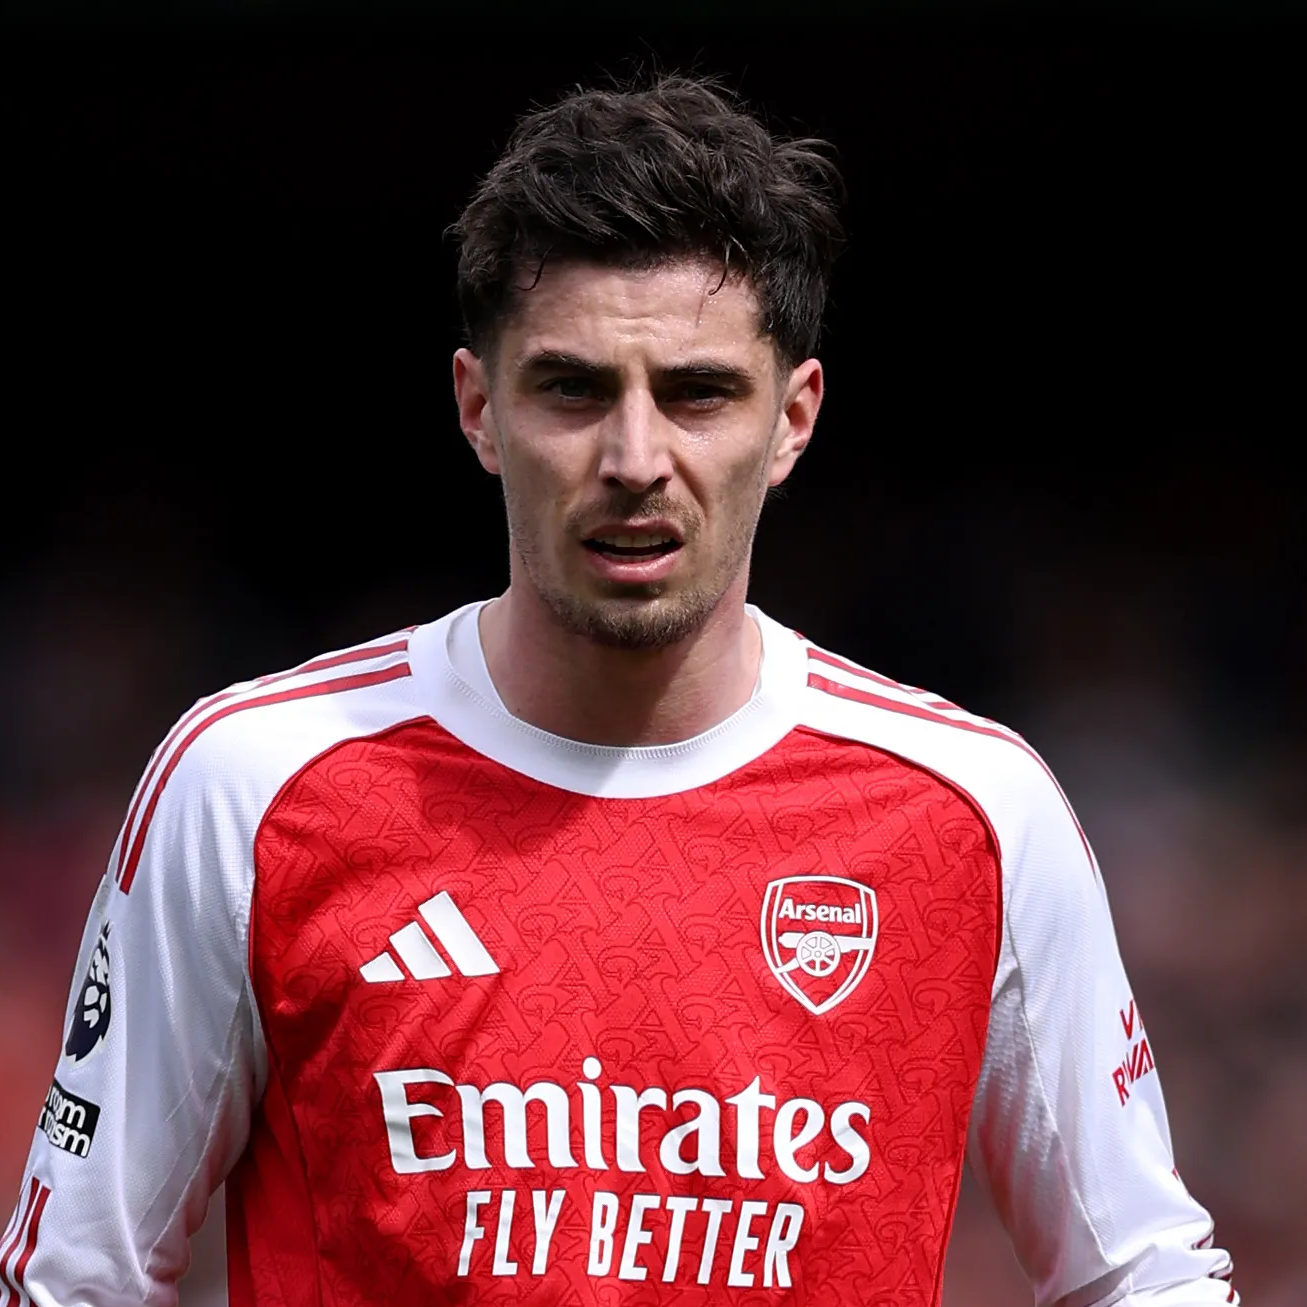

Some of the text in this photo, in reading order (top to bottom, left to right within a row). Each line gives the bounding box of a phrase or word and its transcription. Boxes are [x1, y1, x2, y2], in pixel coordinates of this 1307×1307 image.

[778, 898, 862, 924] Arsenal
[374, 1056, 871, 1184] Emirates
[457, 1189, 804, 1288] FLY BETTER
